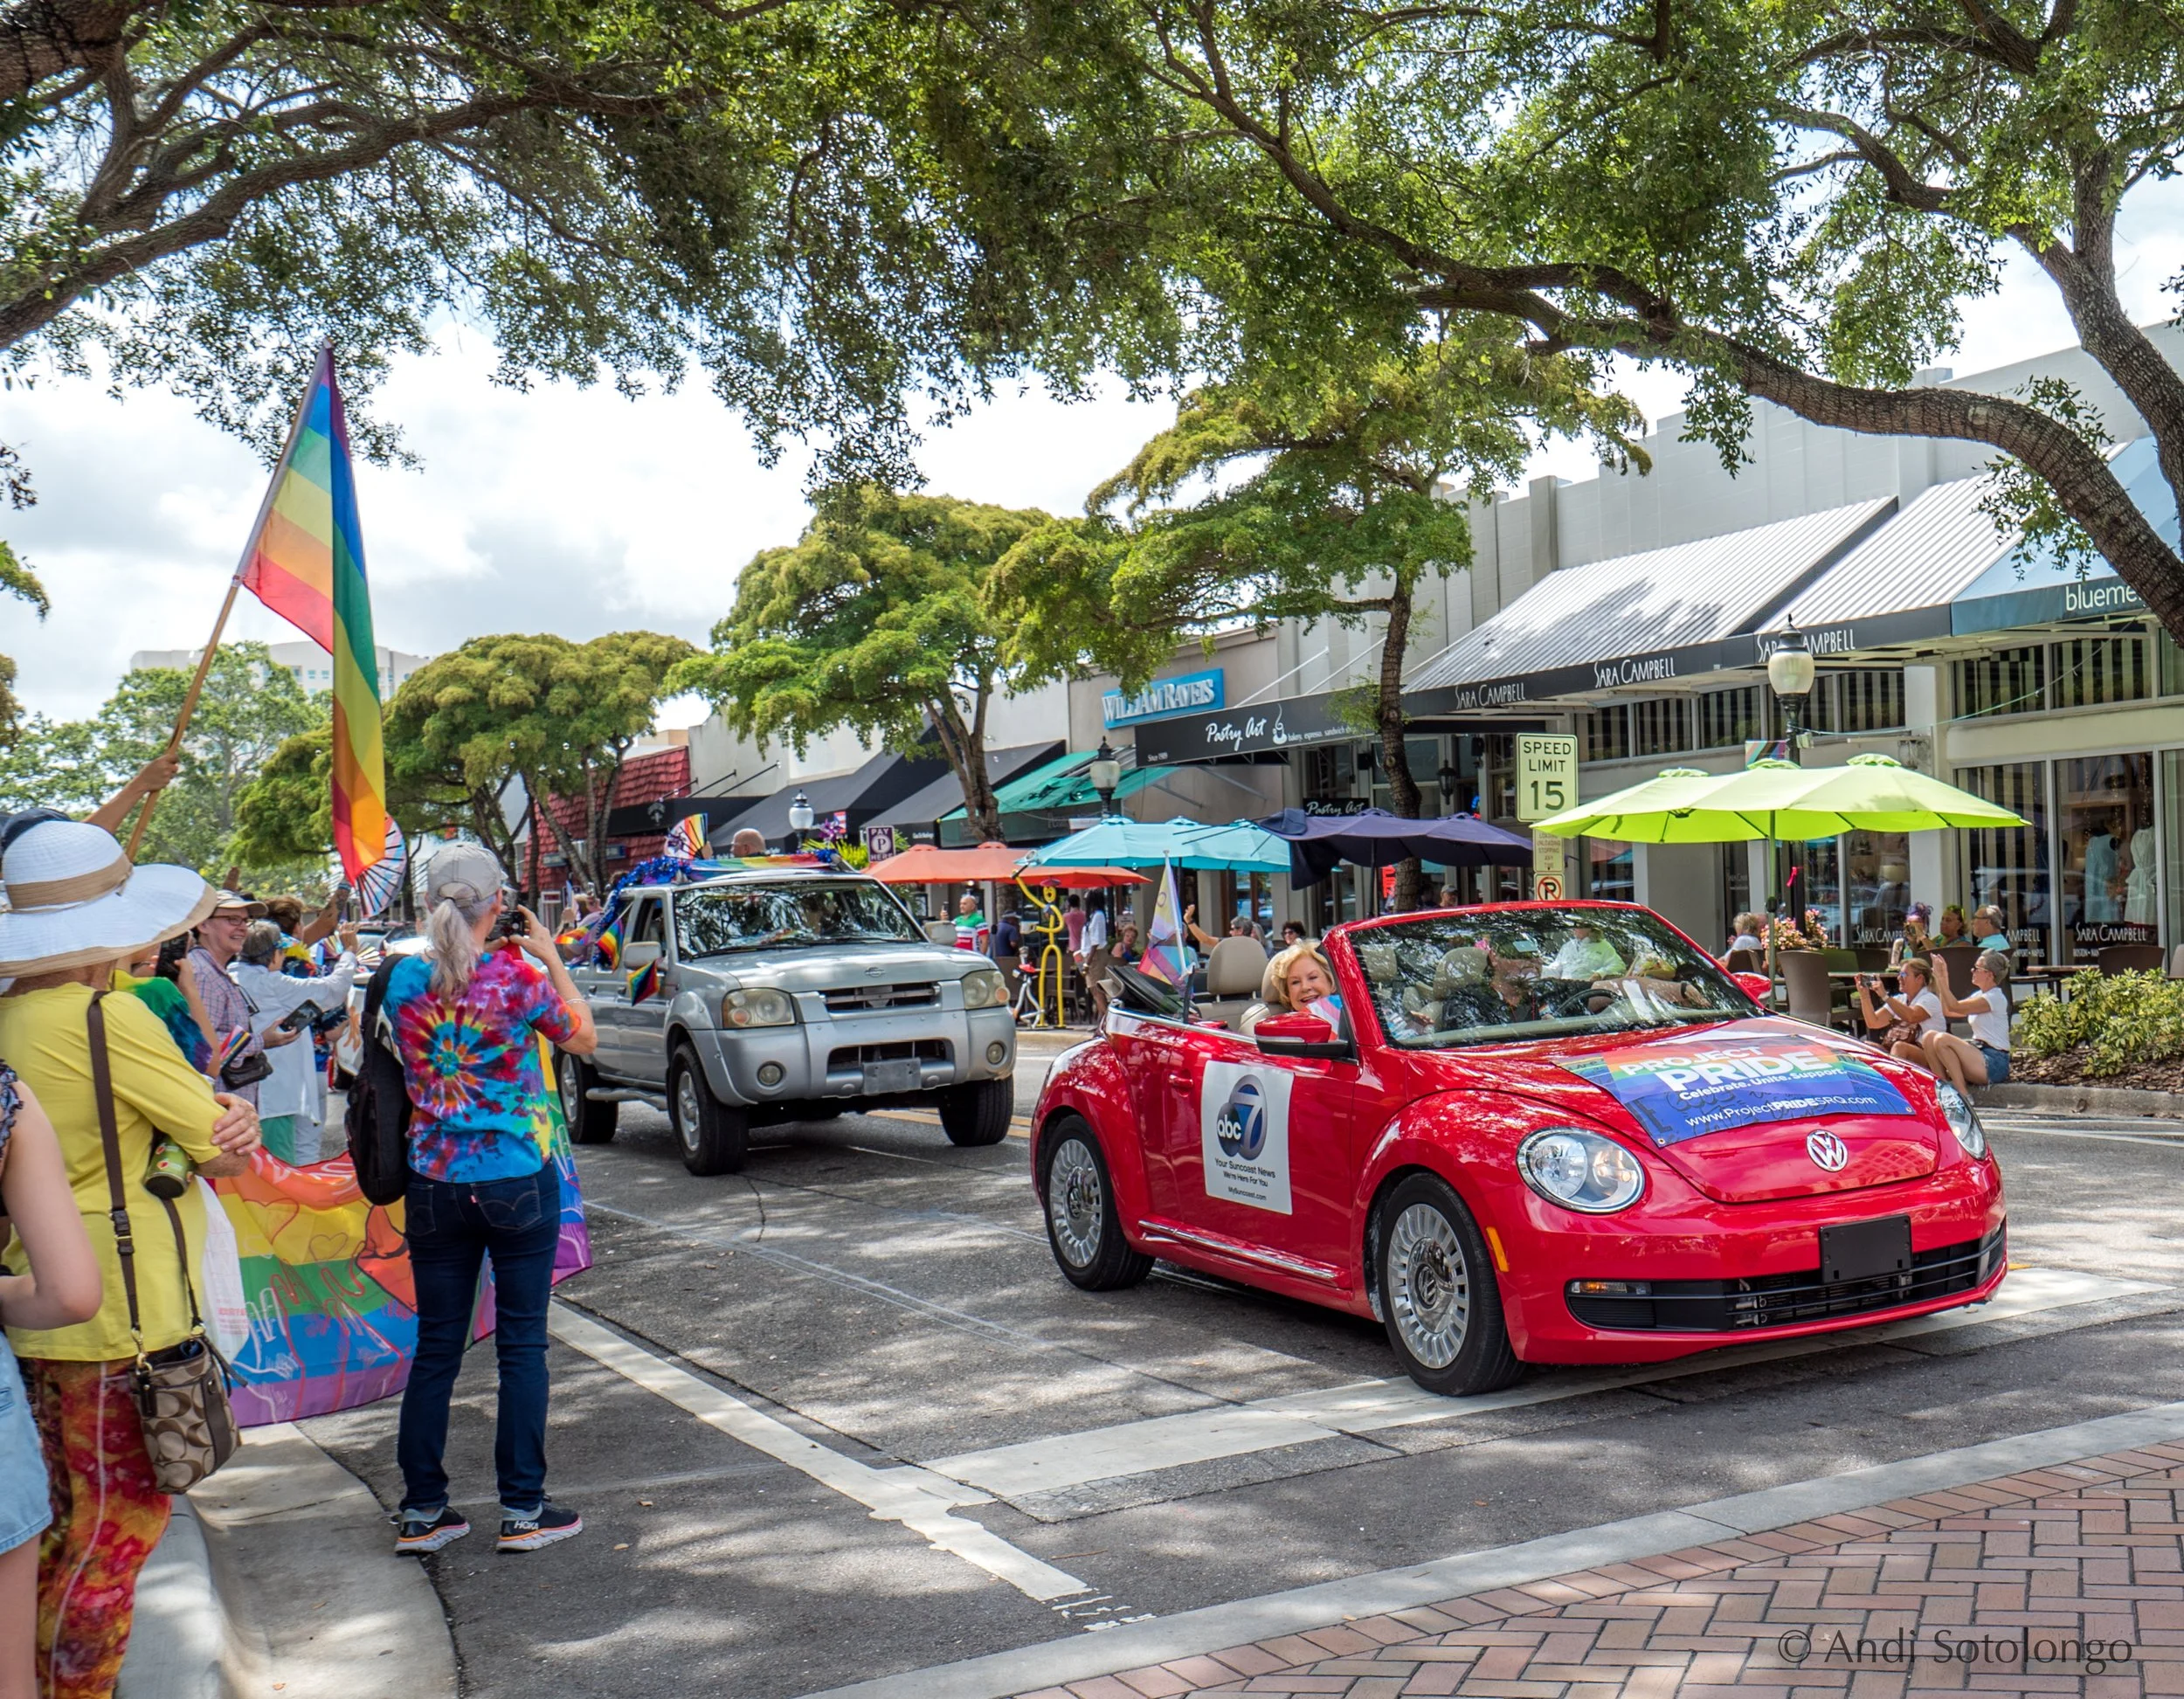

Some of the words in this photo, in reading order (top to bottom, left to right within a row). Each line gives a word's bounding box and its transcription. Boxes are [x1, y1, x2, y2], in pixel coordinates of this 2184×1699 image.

[2066, 584, 2142, 611] blueme
[1802, 629, 1856, 655] AMPBELL
[1594, 661, 1620, 688] SARA
[1621, 657, 1676, 684] CAMPBELL
[1164, 679, 1215, 709] RAVEIS
[1455, 685, 1477, 709] SARA
[1478, 682, 1525, 707] CAMPBELL
[1206, 722, 1243, 751] Pastry
[1246, 716, 1267, 738] Art
[1523, 741, 1572, 756] SPEED
[1529, 759, 1565, 773] LIMIT
[1305, 801, 1342, 816] Pastry
[1346, 800, 1365, 813] Art
[1531, 780, 1565, 811] 15
[1856, 926, 1875, 943] SARA
[2005, 929, 2041, 943] AMPBELL
[2076, 922, 2097, 942] SARA
[2098, 922, 2146, 942] CAMPBELL
[1620, 1046, 1764, 1076] PROJECT
[1655, 1051, 1832, 1092] PRIDE
[1679, 1080, 1751, 1101] Celebrate.
[1752, 1073, 1791, 1087] Unite.
[1792, 1067, 1848, 1082] Support.
[1685, 1095, 1877, 1127] www.ProjectPRIDESRQ.com
[1217, 1114, 1242, 1140] abc
[1215, 1157, 1227, 1167] Your
[1229, 1160, 1256, 1174] Suncoast
[1258, 1167, 1275, 1178] News
[1237, 1173, 1248, 1183] Here
[1249, 1176, 1258, 1184] For
[1258, 1178, 1268, 1187] You
[514, 1520, 539, 1530] HOKA
